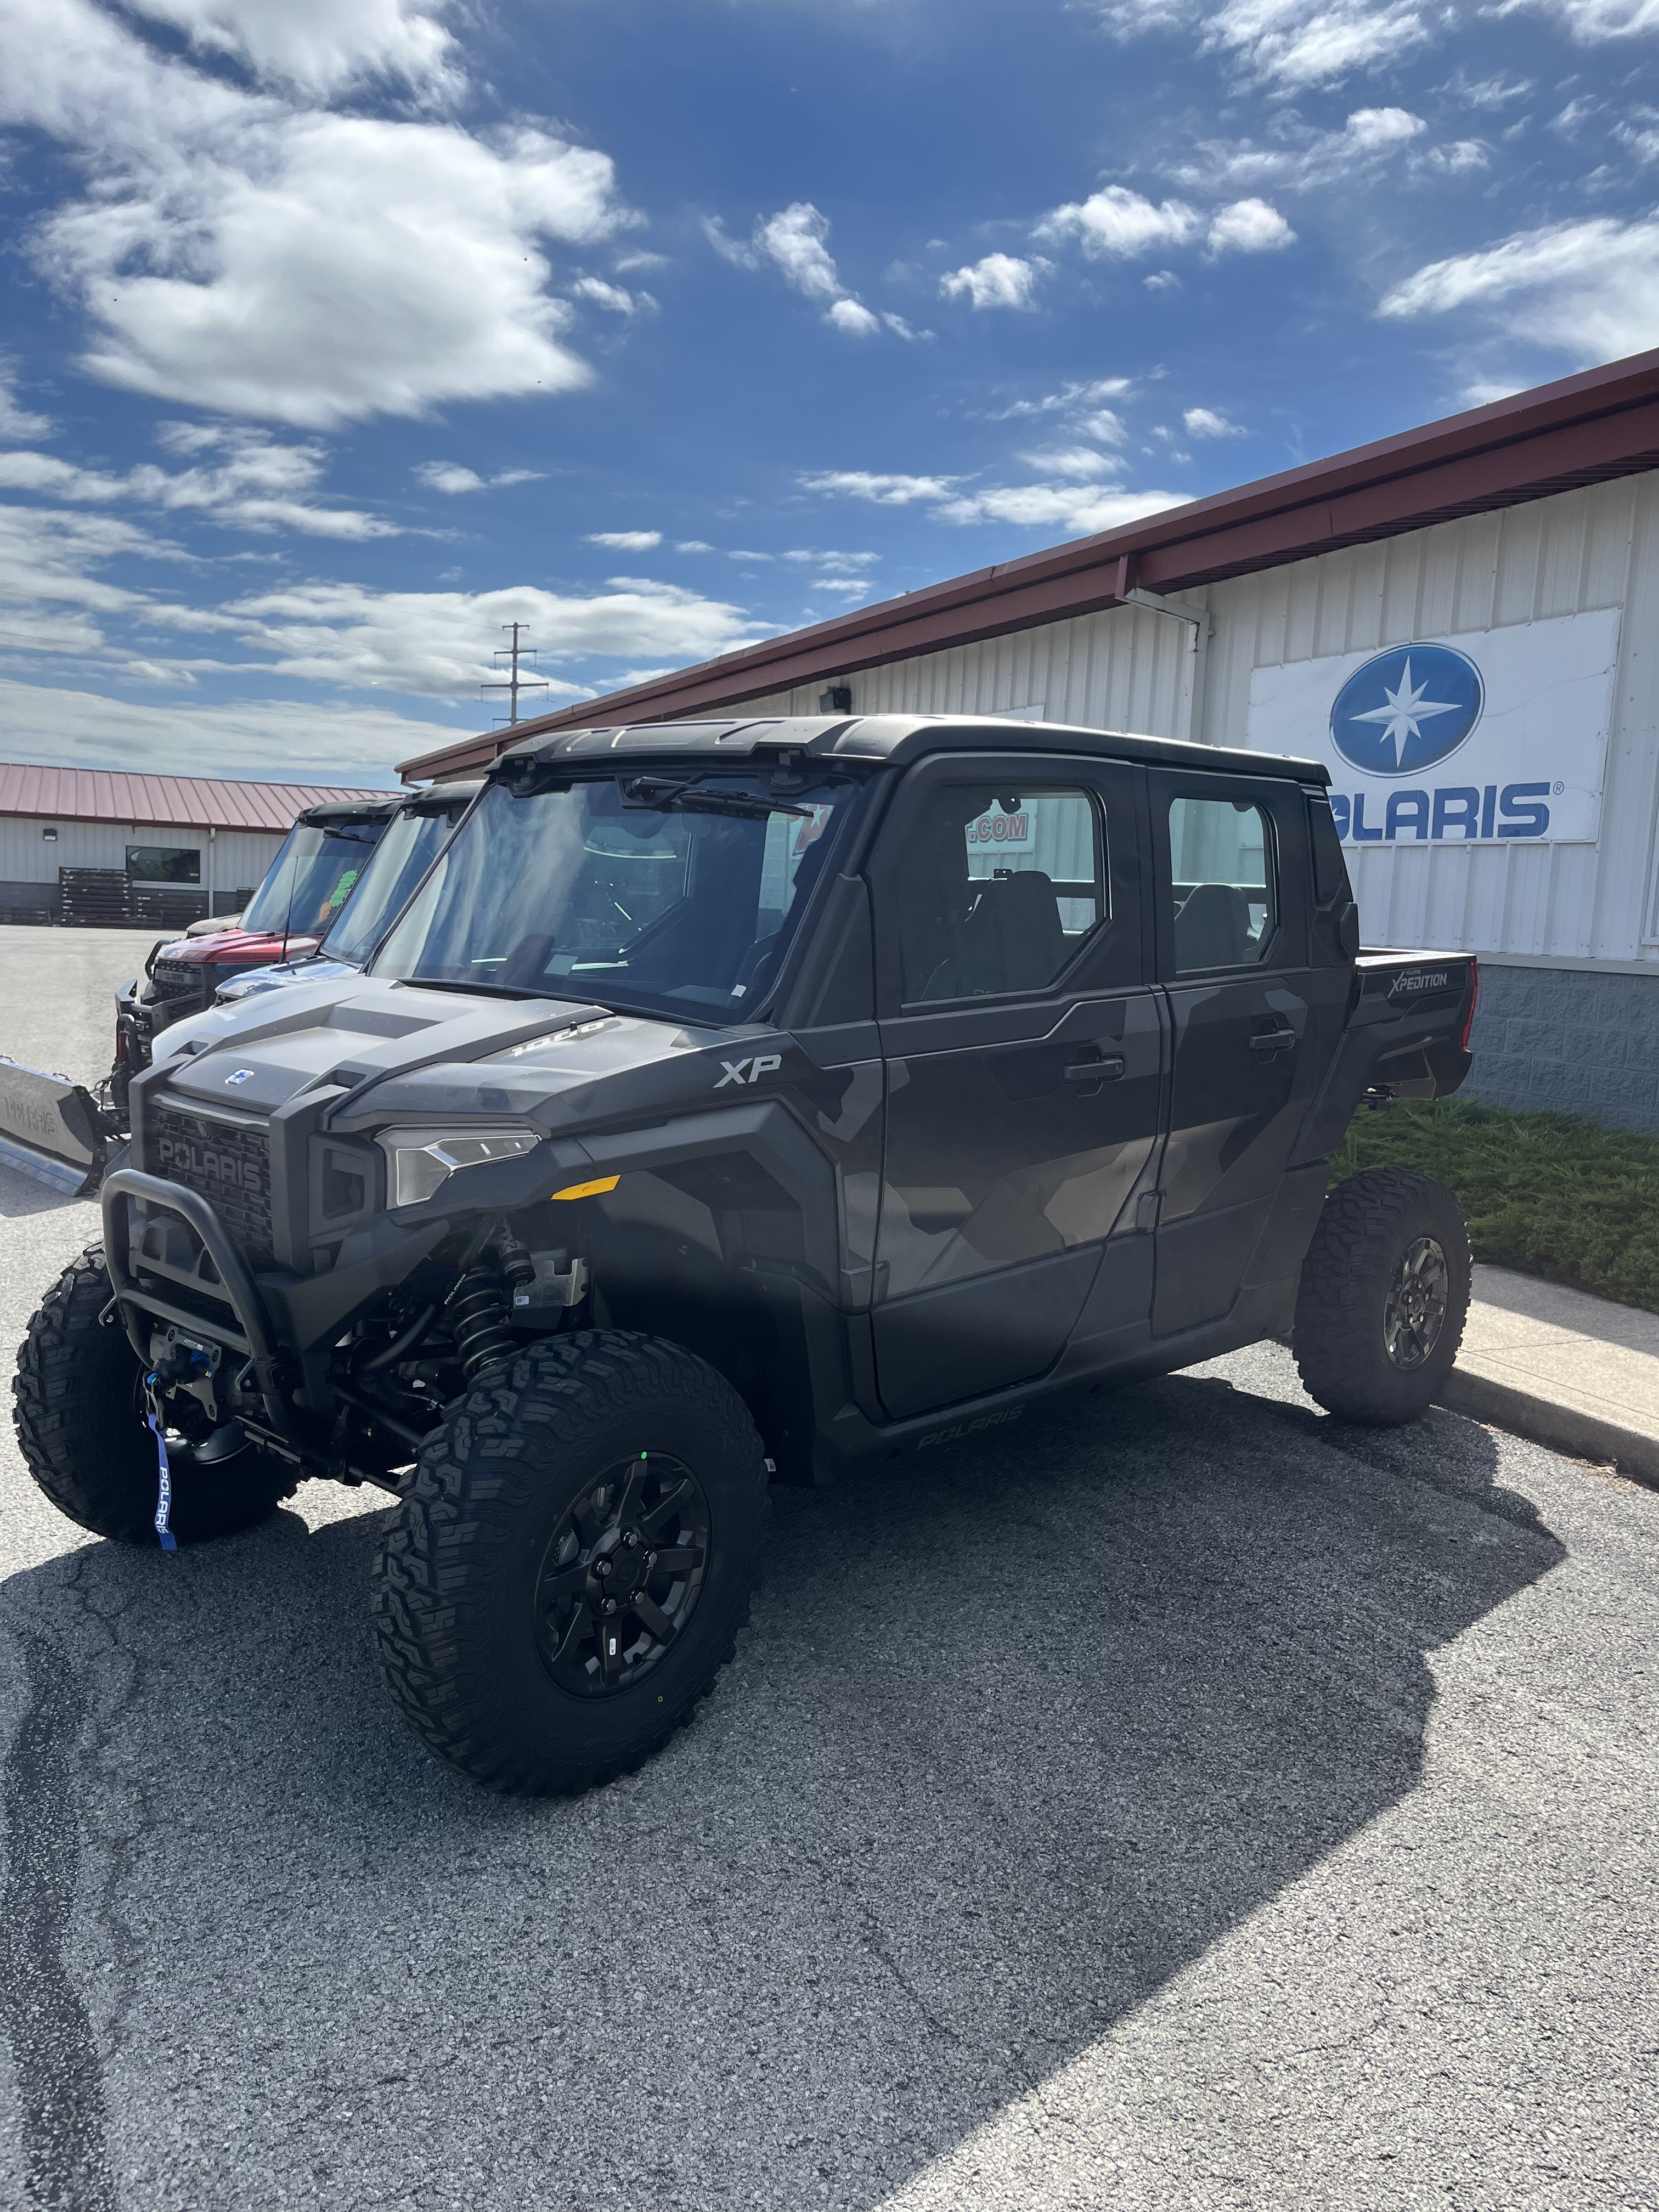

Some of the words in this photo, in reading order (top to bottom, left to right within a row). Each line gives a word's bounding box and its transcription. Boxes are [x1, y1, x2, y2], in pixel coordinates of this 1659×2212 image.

[965, 813, 1029, 843] .COM
[1328, 782, 1551, 841] LARIS
[1387, 971, 1447, 998] XPEDITION
[512, 1021, 604, 1057] 1000
[713, 1054, 782, 1088] XP
[157, 1137, 262, 1194] POLARIS
[444, 1273, 467, 1305] POLARIS
[916, 1403, 1025, 1452] POLARIS
[156, 1466, 170, 1534] POLARIS
